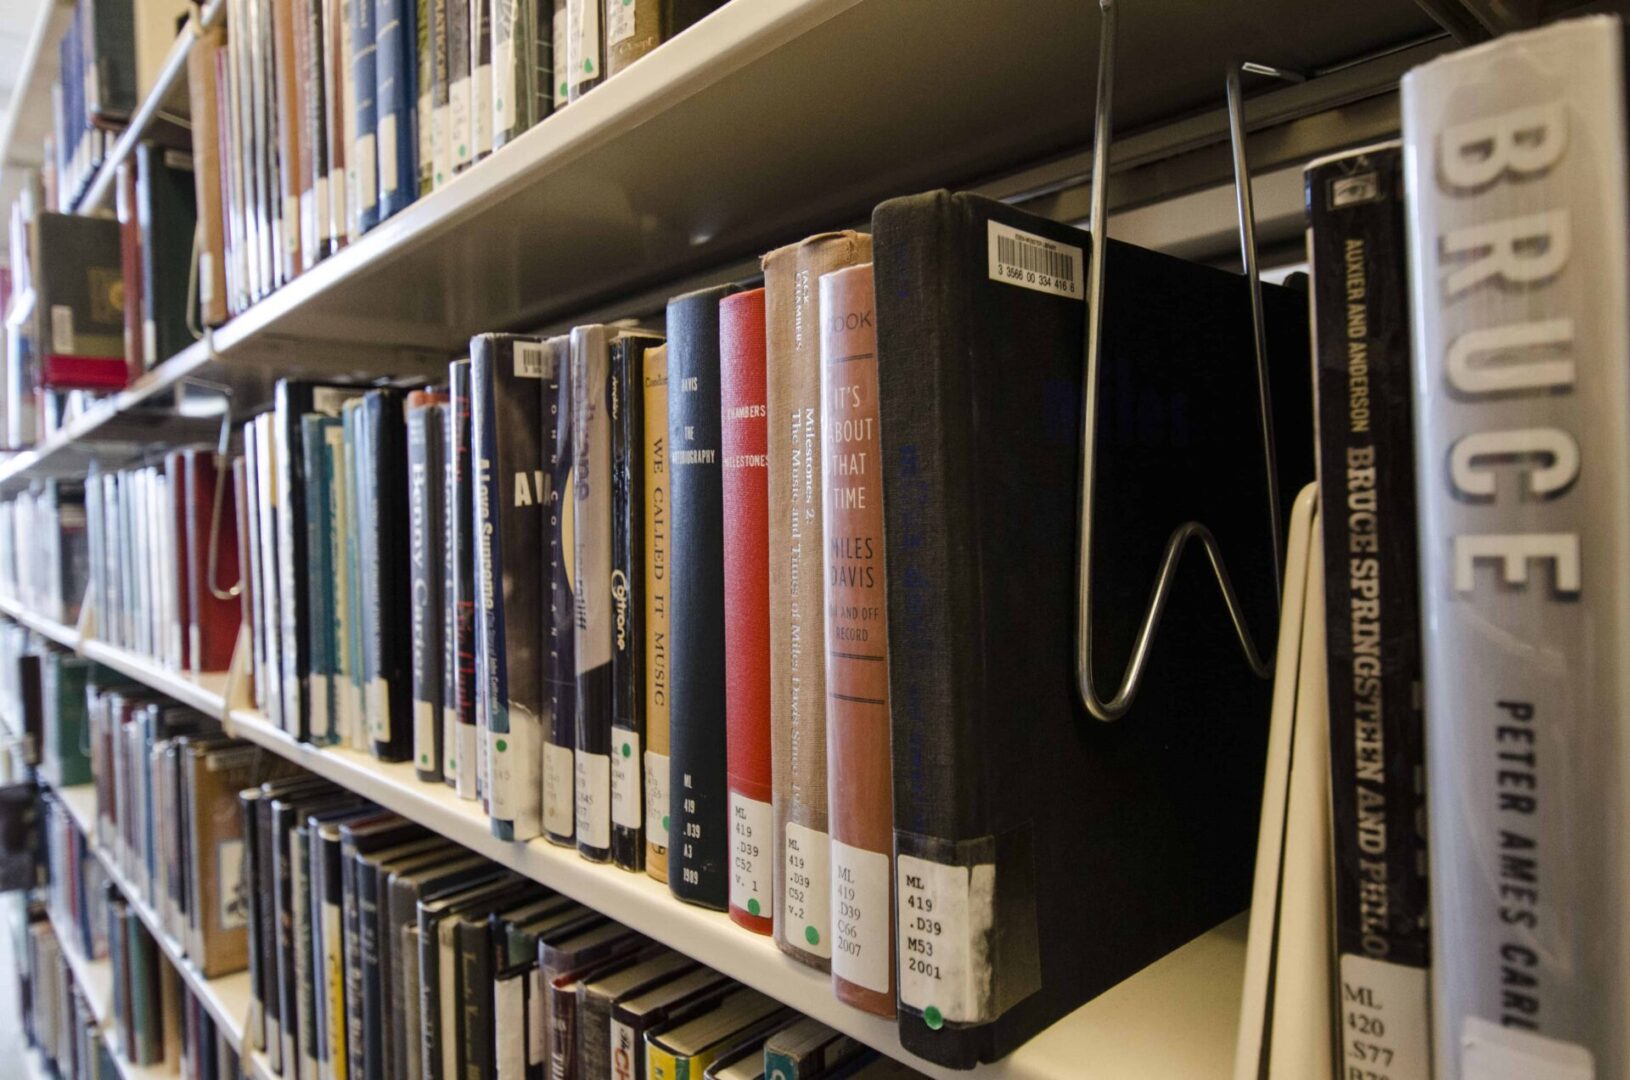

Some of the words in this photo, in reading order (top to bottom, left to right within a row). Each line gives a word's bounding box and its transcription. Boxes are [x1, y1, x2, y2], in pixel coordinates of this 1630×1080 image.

[1345, 239, 1365, 300] AUXIER
[1348, 303, 1367, 338] AND
[1437, 103, 1582, 598] BRUCE
[834, 385, 861, 409] IT'S
[1349, 342, 1370, 433] ANDERSON
[550, 382, 558, 464] JOHN
[791, 409, 802, 443] The
[653, 437, 664, 474] WE
[805, 408, 815, 503] Milestones
[832, 453, 866, 475] THAT
[791, 449, 802, 503] Music
[833, 487, 866, 509] TIME
[1347, 446, 1378, 554] BRUCE
[413, 463, 427, 569] Benny
[791, 507, 802, 538] and
[653, 487, 664, 580] CALLED
[791, 543, 802, 596] Times
[831, 566, 875, 588] DAVIS
[612, 568, 627, 651] Coltrane
[654, 595, 665, 618] IT
[791, 602, 802, 619] of
[841, 607, 858, 620] AND
[862, 607, 879, 621] OFF
[413, 578, 429, 684] Carter
[836, 626, 869, 642] RECORD
[791, 624, 802, 670] Miles
[654, 633, 666, 707] MUSIC
[1350, 558, 1385, 783] SPRINGSTEEN
[791, 676, 802, 727] Davis
[790, 728, 802, 776] Since
[1496, 701, 1538, 815] PETER
[684, 798, 695, 814] 419
[735, 805, 747, 820] ML
[736, 821, 752, 838] 419
[1356, 786, 1387, 855] AND
[684, 843, 693, 859] A3
[736, 841, 759, 858] .D39
[788, 838, 800, 851] ML
[735, 857, 752, 873] C52
[789, 855, 804, 869] 419
[683, 867, 698, 886] 1989
[790, 872, 810, 889] .D39
[838, 866, 855, 884] ML
[906, 875, 924, 890] ML
[1499, 831, 1539, 931] AMES
[789, 887, 804, 903] C52
[908, 895, 933, 912] 419
[838, 920, 857, 938] C66
[910, 917, 942, 936] .D39
[838, 936, 862, 957] 2007
[907, 937, 933, 957] M53
[909, 958, 942, 980] 2001
[1344, 983, 1383, 1010] ML
